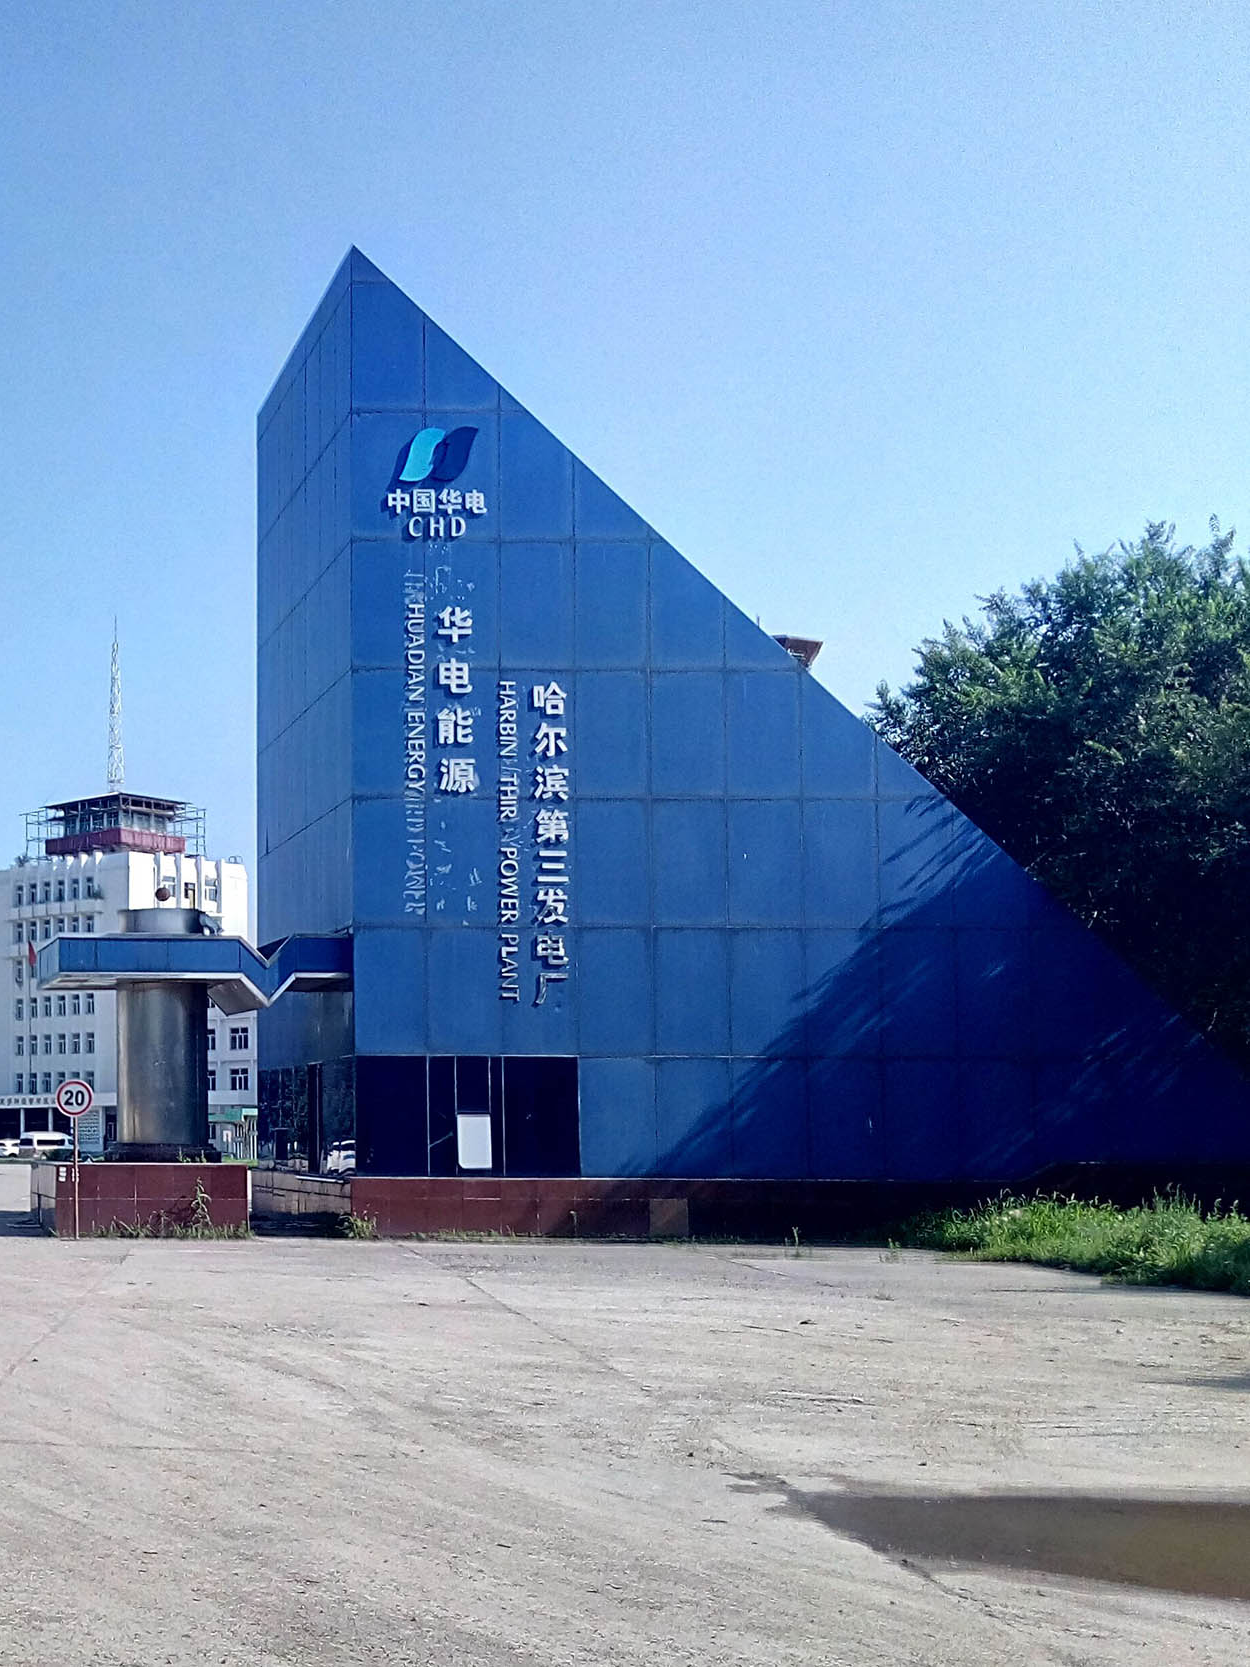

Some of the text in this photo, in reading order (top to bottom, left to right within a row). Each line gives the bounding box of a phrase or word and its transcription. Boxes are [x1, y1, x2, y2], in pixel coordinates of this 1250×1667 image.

[387, 488, 488, 515] 中国华电
[408, 516, 467, 538] CHD
[407, 604, 426, 702] HUADIAN
[437, 605, 475, 793] 华电能源
[499, 681, 518, 757] HARBIN
[407, 711, 426, 793] ENERGY
[533, 681, 570, 1005] 哈尔滨第三发电厂
[500, 847, 519, 922] POWER
[501, 933, 520, 1002] PLANT
[63, 1089, 85, 1107] 20
